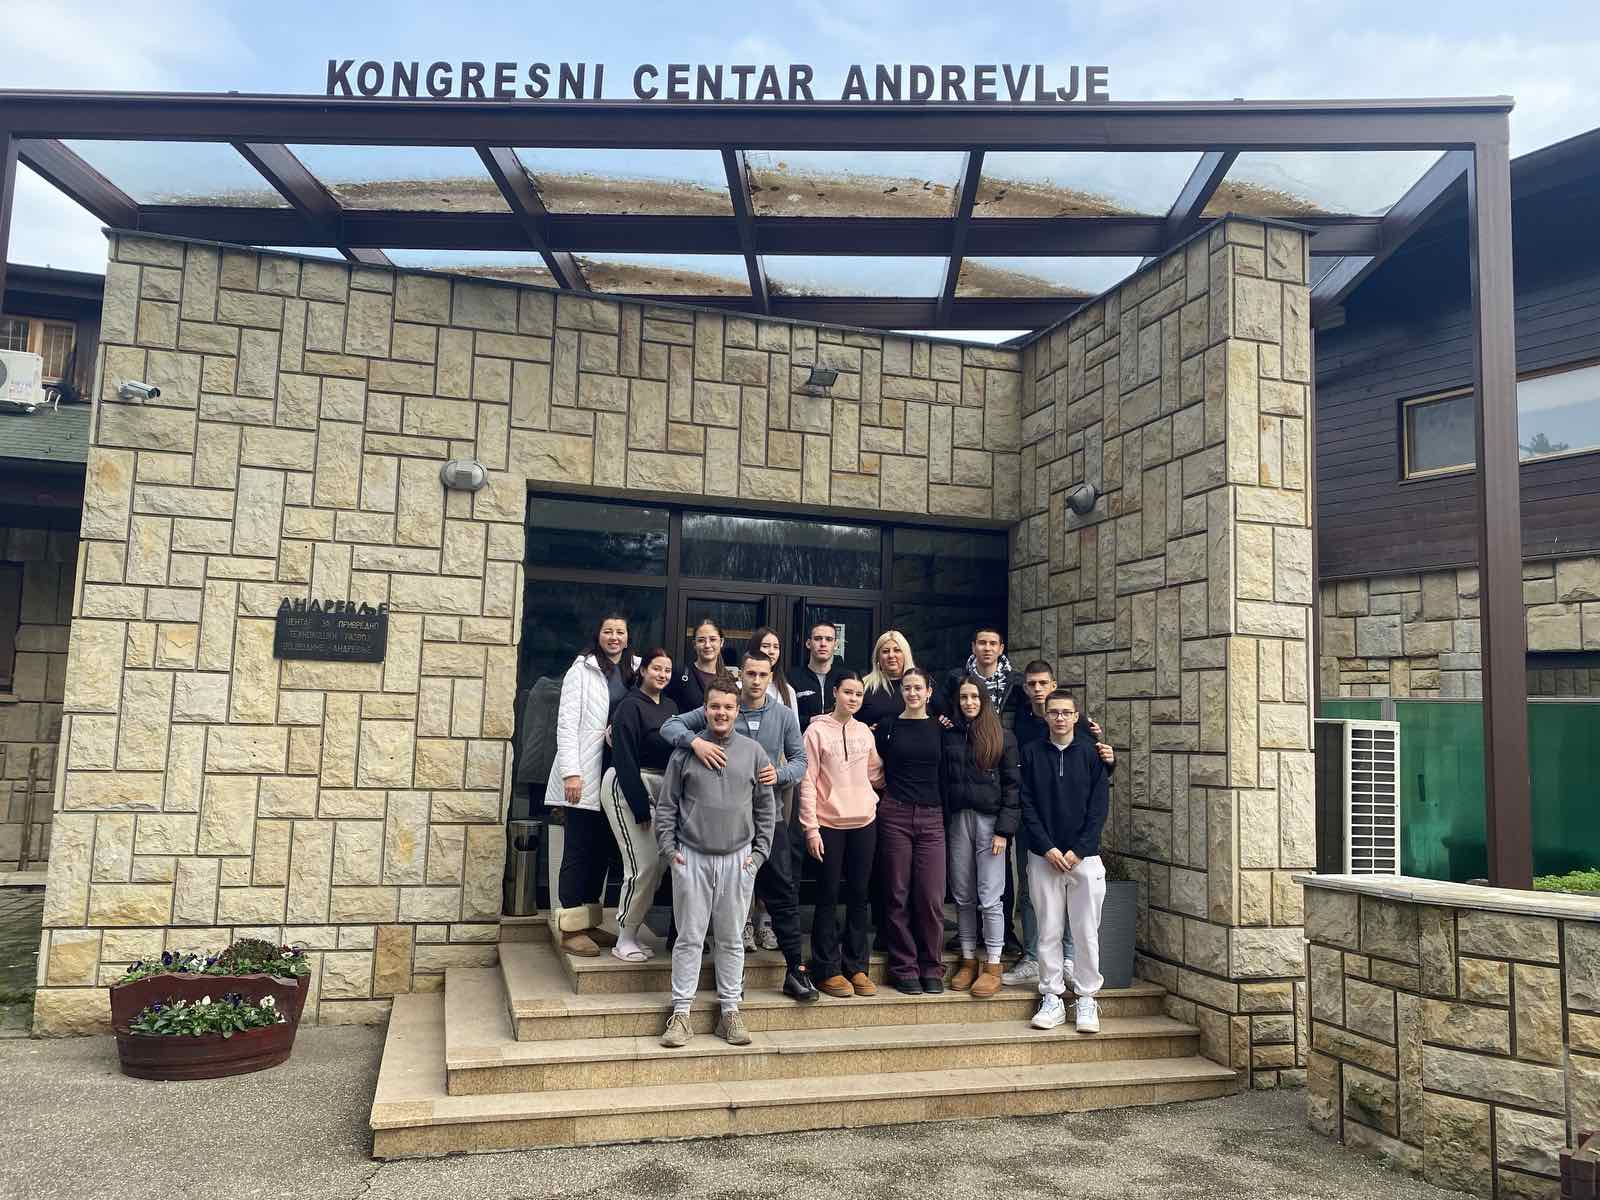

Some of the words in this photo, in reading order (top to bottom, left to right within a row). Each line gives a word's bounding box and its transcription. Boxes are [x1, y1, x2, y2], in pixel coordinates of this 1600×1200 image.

[326, 59, 604, 99] KONGRESNI
[633, 63, 814, 102] CENTAR
[840, 64, 1110, 103] ANDREVLJE
